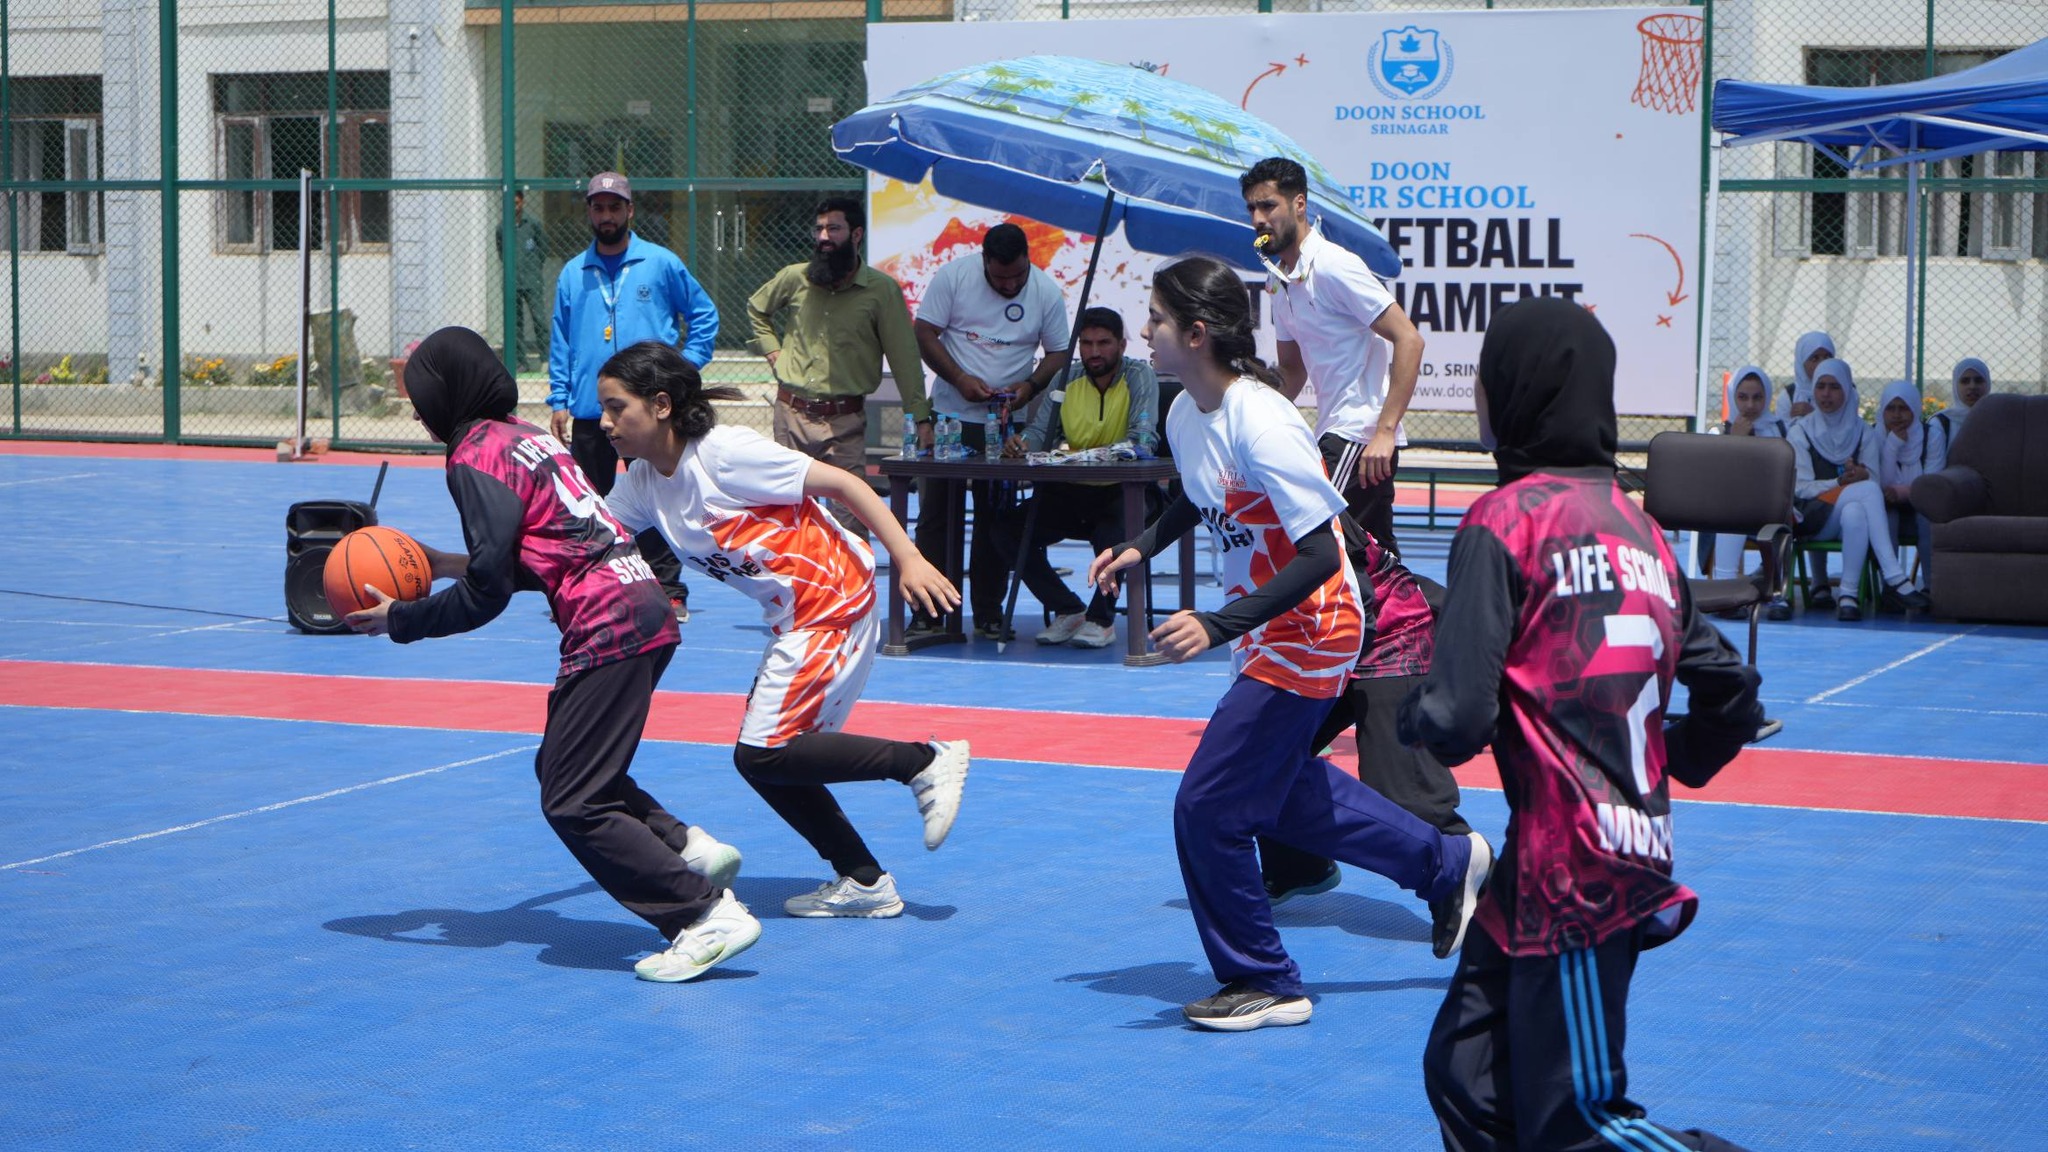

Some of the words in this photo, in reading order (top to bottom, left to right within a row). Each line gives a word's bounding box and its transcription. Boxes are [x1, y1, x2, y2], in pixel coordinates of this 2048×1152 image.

[1335, 105, 1396, 120] DOON
[1401, 105, 1486, 120] SCHOOL
[1371, 123, 1449, 135] SRINAGAR
[1370, 162, 1450, 181] DOON
[1397, 185, 1535, 209] SCHOOL
[1373, 217, 1575, 269] ETBALL
[1444, 363, 1480, 377] SRIN
[1551, 544, 1615, 597] LIFE
